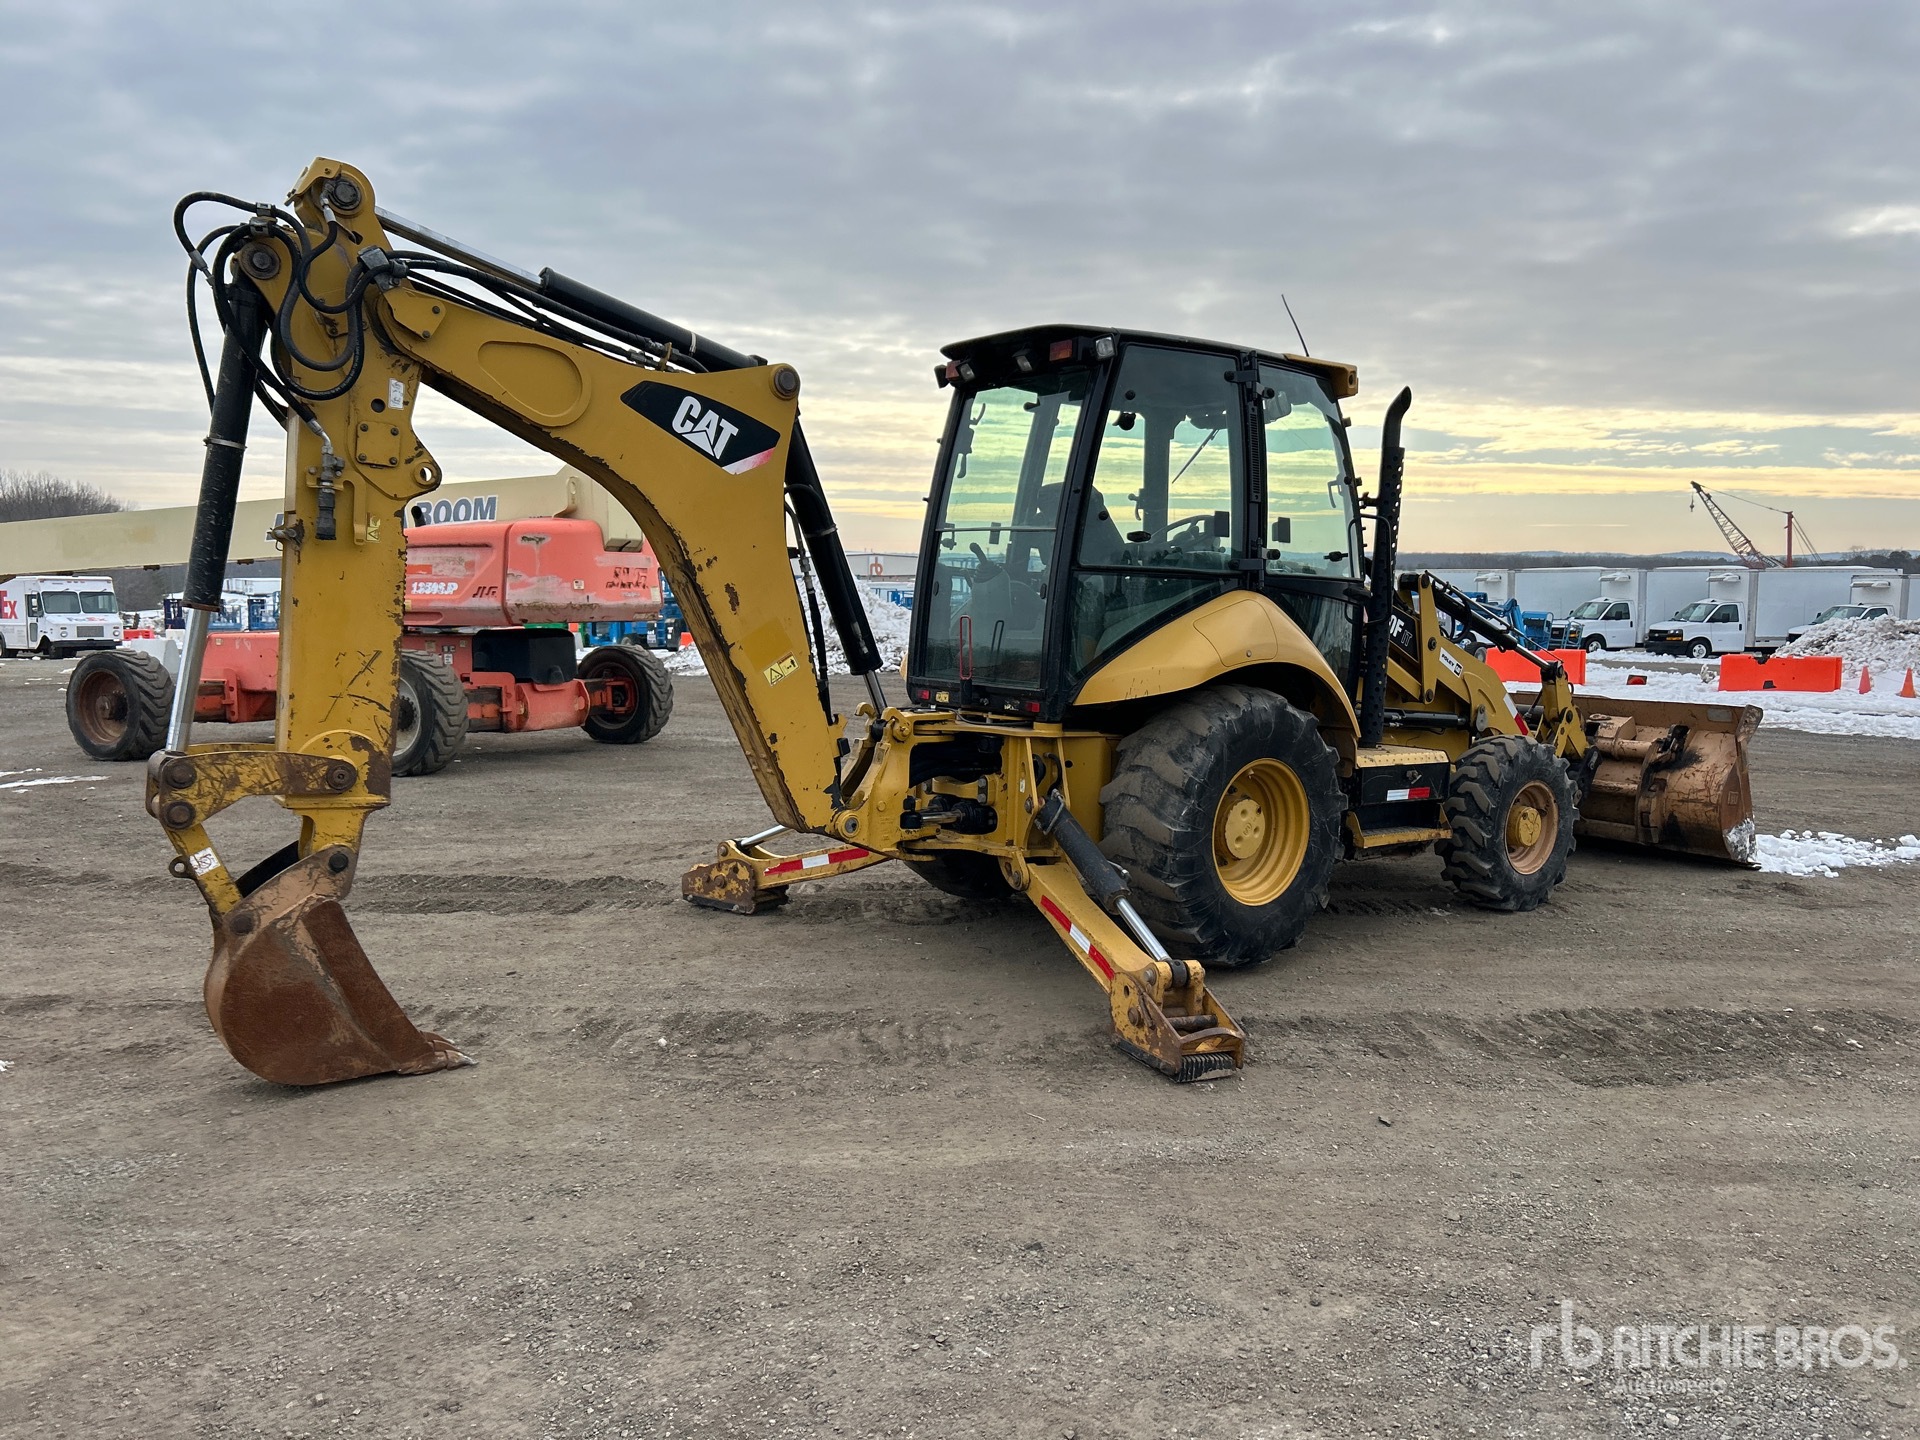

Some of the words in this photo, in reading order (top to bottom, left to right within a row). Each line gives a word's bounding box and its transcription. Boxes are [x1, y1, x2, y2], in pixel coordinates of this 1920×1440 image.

[672, 395, 739, 460] CAT
[416, 496, 498, 525] BOOM
[1441, 653, 1455, 667] FOLEY
